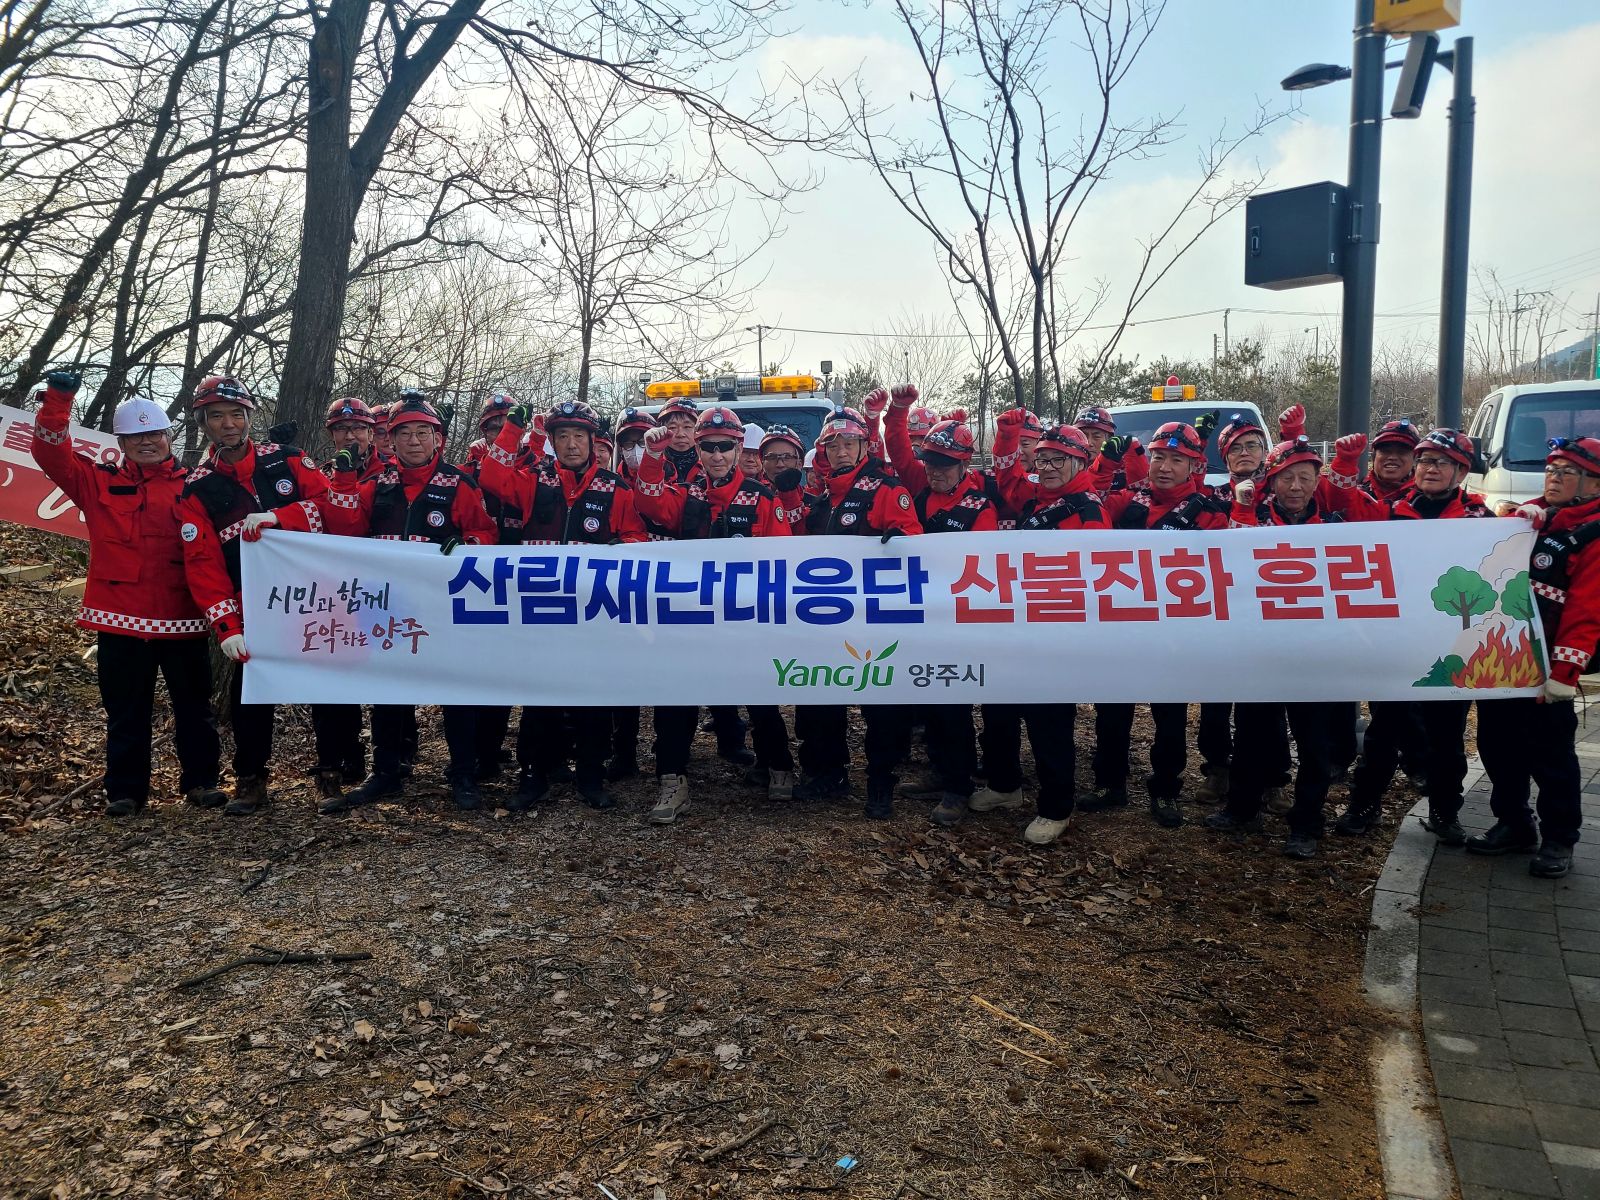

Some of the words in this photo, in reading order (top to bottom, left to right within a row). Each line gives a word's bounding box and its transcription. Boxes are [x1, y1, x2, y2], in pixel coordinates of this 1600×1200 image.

[585, 502, 603, 511] 양주시
[947, 518, 965, 530] 양주시
[267, 581, 336, 614] 시민과
[337, 578, 390, 614] 함께
[448, 556, 929, 625] 산림재난대응단
[950, 547, 1234, 624] 산불진화
[1252, 543, 1400, 621] 훈련
[302, 618, 369, 654] 도약하는
[372, 616, 429, 654] 양주
[908, 663, 985, 688] 양주시
